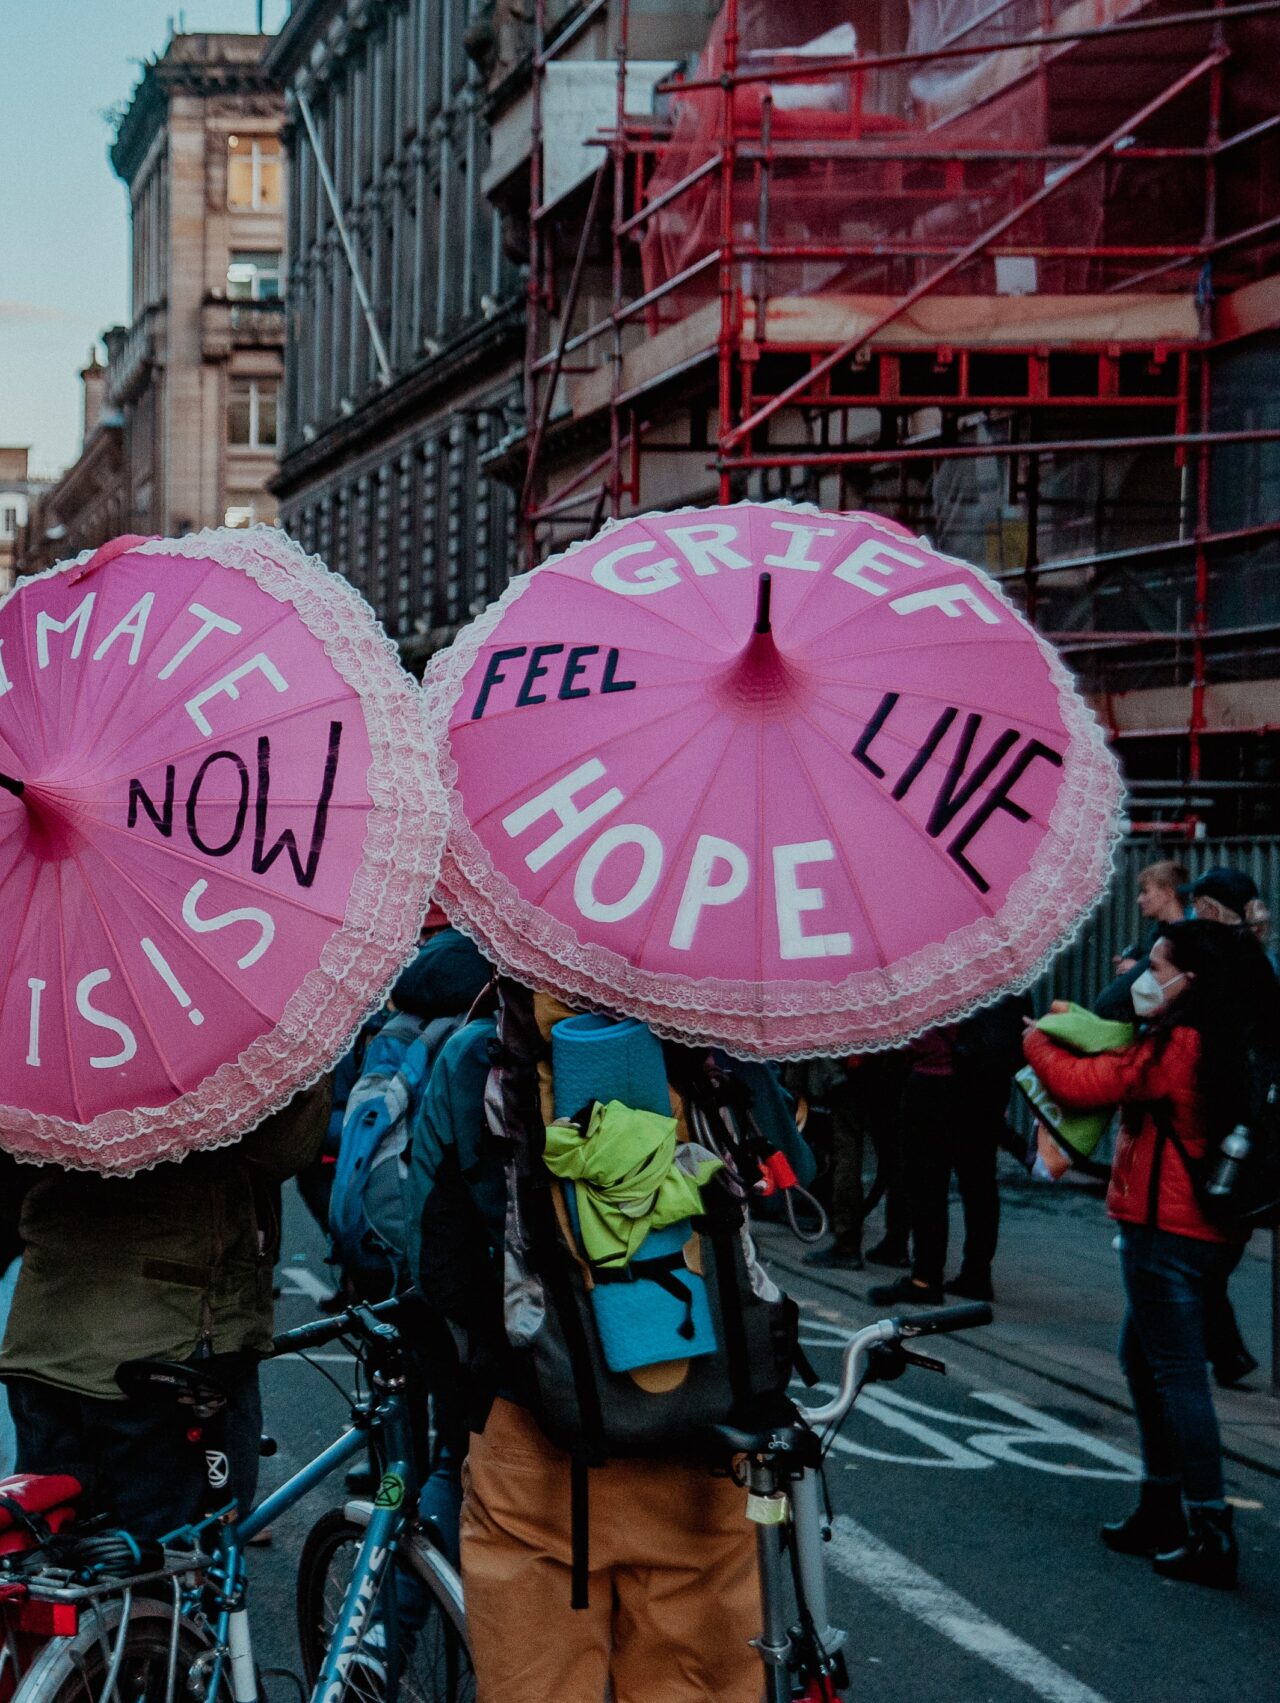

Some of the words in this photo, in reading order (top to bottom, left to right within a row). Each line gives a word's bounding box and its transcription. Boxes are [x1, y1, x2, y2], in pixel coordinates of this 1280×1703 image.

[591, 522, 1001, 625] GRIEF
[472, 643, 636, 720] FEEL
[127, 721, 342, 888] NOW
[502, 757, 853, 960] HOPE
[852, 692, 1063, 893] LIVE
